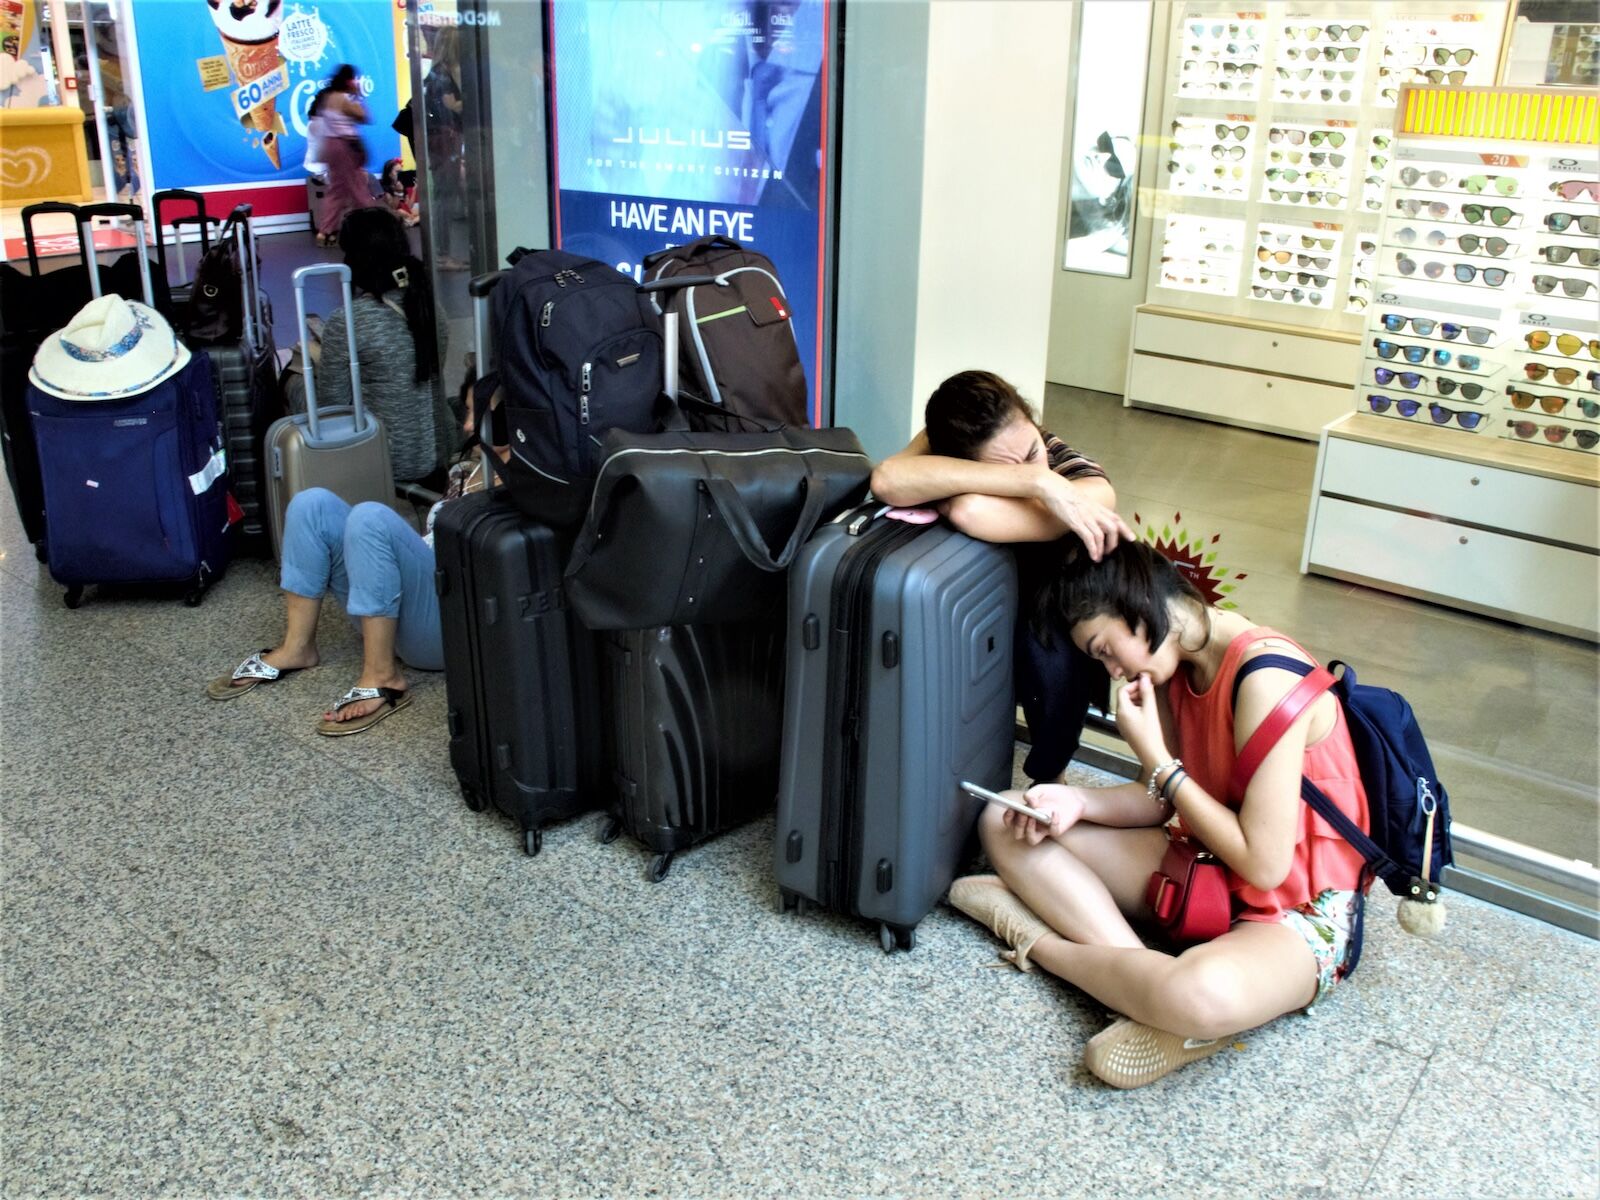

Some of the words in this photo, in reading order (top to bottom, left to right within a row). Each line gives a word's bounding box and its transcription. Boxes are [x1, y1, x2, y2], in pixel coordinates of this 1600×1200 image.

[286, 19, 312, 31] LATTE
[287, 27, 315, 38] FRESCO
[238, 83, 262, 110] 60
[612, 127, 751, 150] JULIUS
[587, 158, 613, 168] FOR
[620, 160, 647, 170] THE
[714, 164, 783, 180] CITIZEN
[611, 200, 668, 233] HAVE
[671, 206, 704, 237] AN
